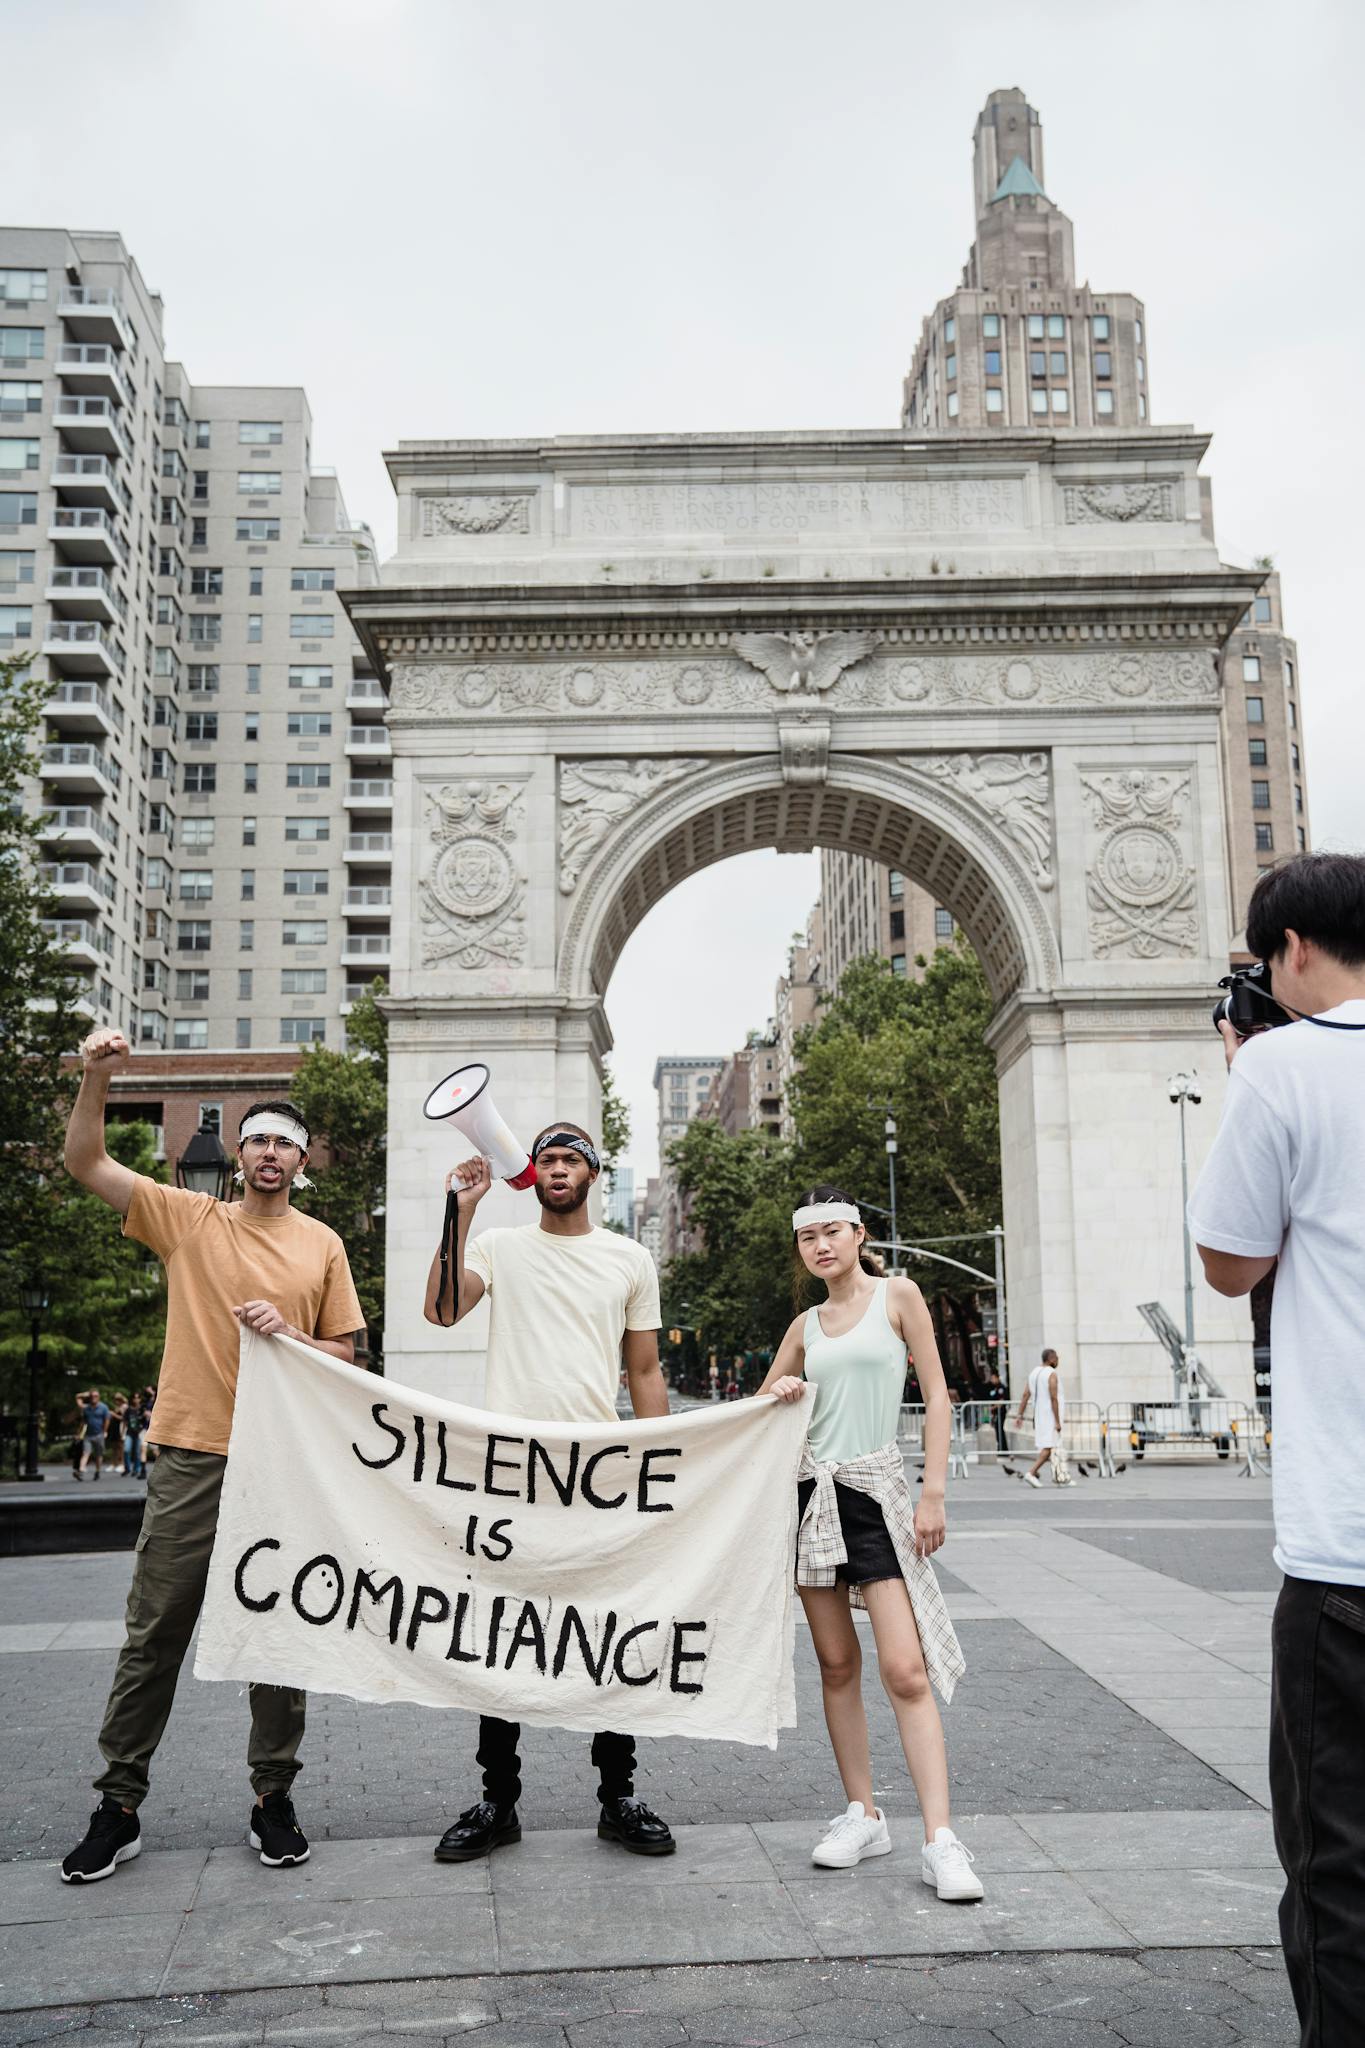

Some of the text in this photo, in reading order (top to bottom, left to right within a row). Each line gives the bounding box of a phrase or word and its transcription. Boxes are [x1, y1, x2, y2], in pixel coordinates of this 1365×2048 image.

[583, 488, 616, 502] LET
[646, 486, 697, 501] RAISE
[705, 486, 718, 500] A
[722, 485, 821, 500] STANDARD
[829, 484, 853, 499] TO
[859, 482, 920, 498] WHICH
[928, 482, 961, 497] THE
[967, 481, 1014, 496] WISE
[583, 496, 1014, 516] AND THE HONEST CAN REPAIR THE EVENT
[582, 511, 1015, 532] IS IN THE HAND OF GOD WASHINGTON
[352, 1403, 682, 1512] SILENCE
[465, 1515, 513, 1561] IS
[235, 1538, 707, 1693] COMPLIANCE
